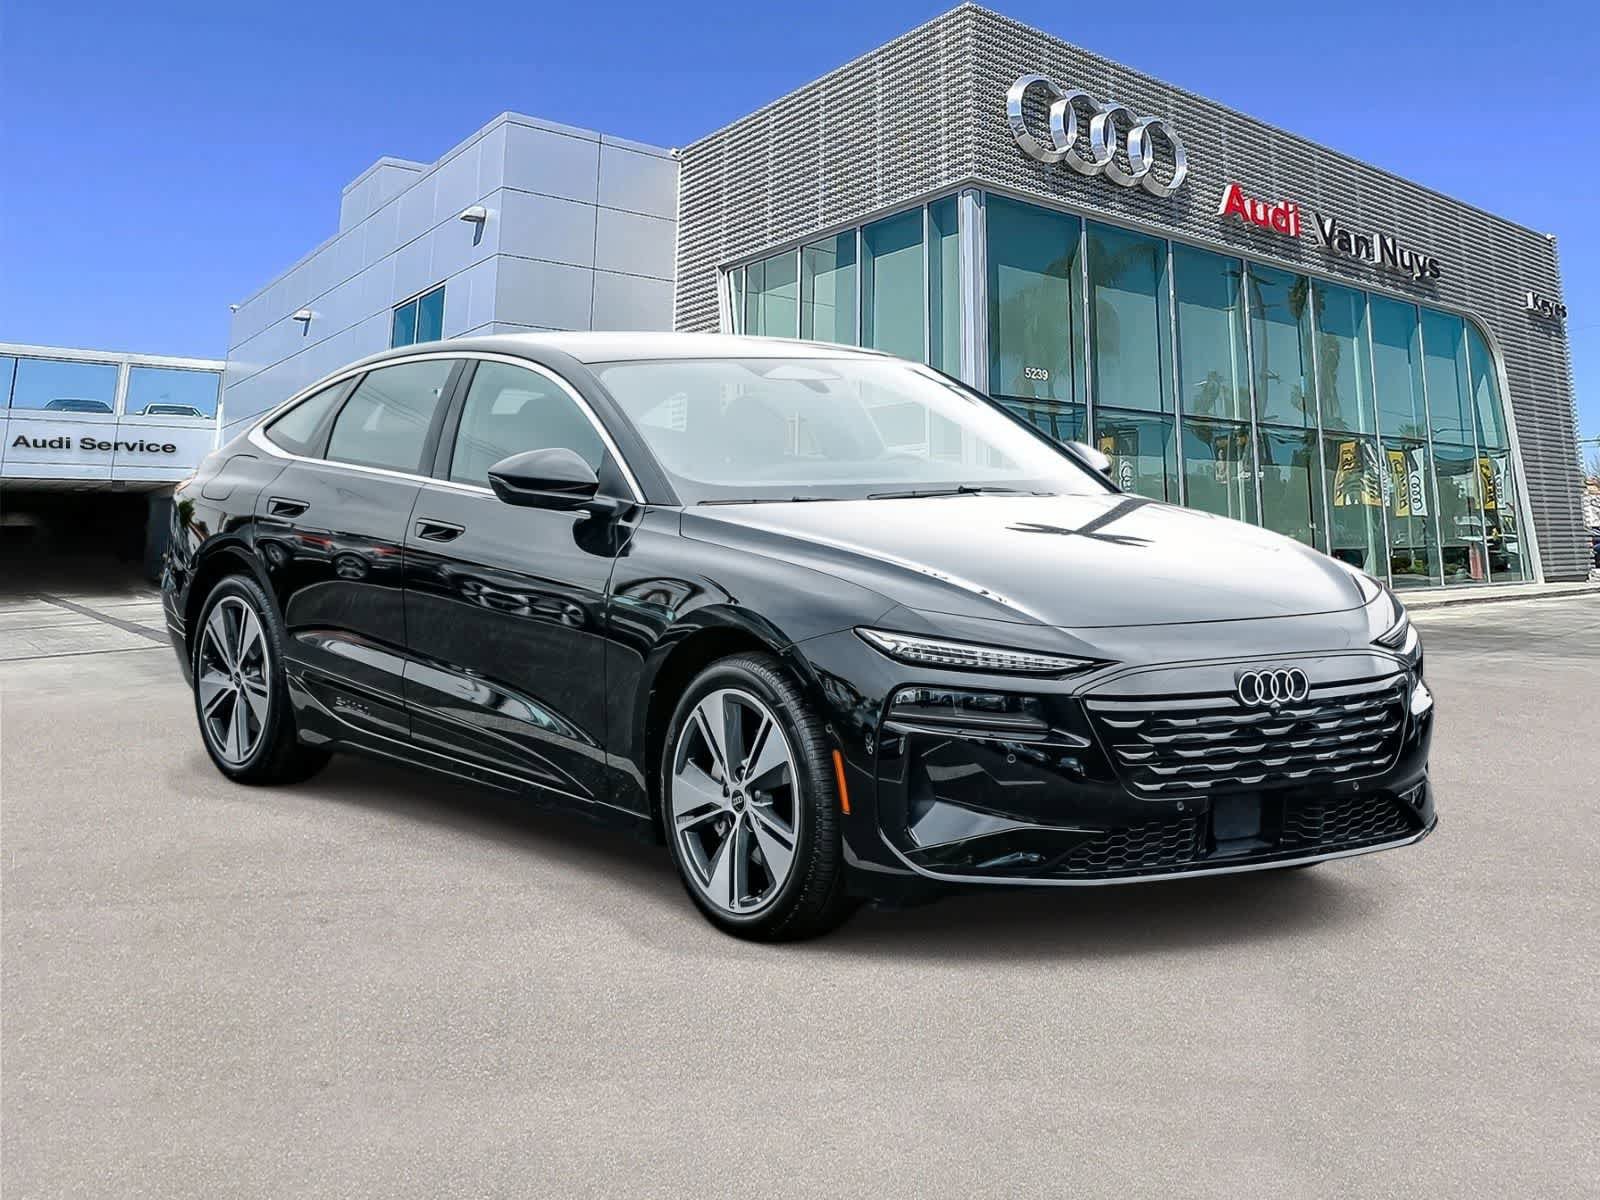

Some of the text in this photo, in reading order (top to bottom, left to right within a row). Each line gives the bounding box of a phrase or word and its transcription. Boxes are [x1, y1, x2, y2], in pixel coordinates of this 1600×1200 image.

[1218, 182, 1441, 281] Audi Van Nuys
[1024, 367, 1049, 381] 5239
[12, 435, 177, 453] Audi Service
